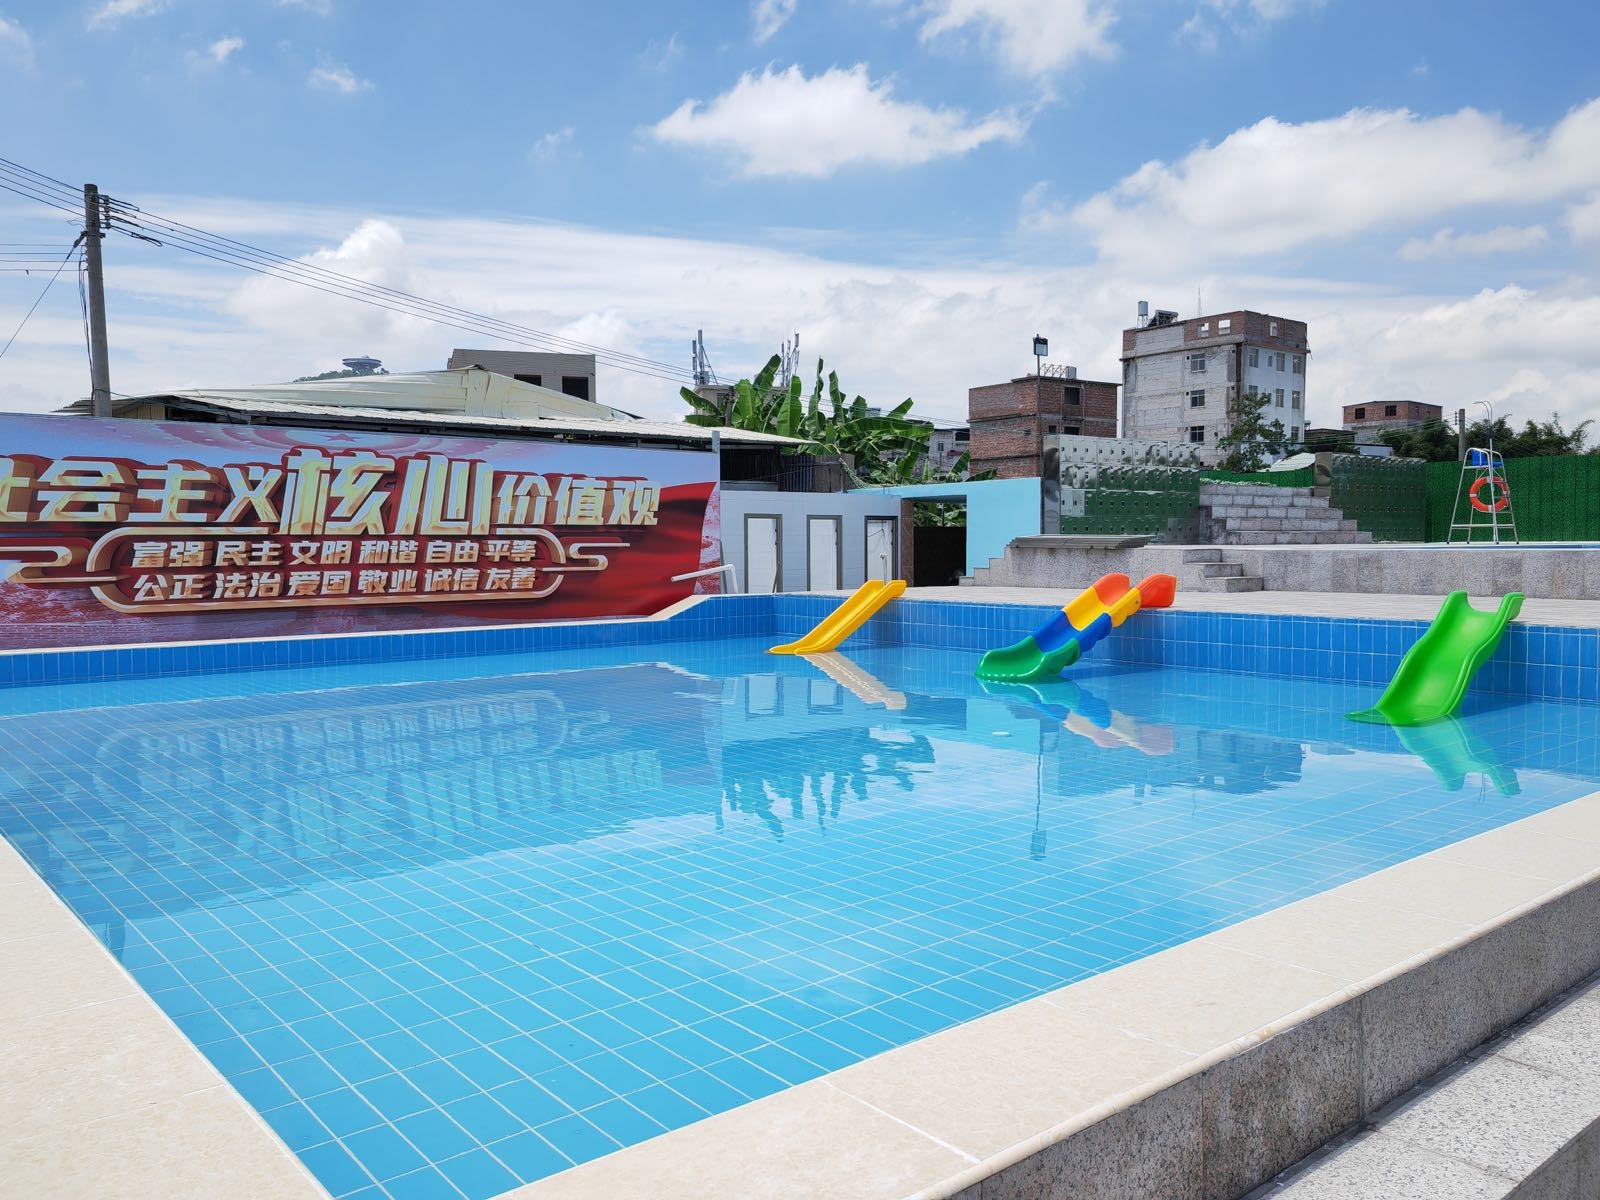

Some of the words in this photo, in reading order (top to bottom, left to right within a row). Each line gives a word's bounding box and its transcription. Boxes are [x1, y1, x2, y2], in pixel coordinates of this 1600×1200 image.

[132, 541, 205, 568] 富强
[215, 541, 282, 566] 民主
[289, 540, 352, 565] 文明
[358, 540, 418, 564] 和谐
[425, 540, 480, 563] 自由
[486, 540, 537, 562] 平等
[133, 574, 204, 601] 公正
[213, 571, 282, 598] 法治
[288, 570, 352, 596] 爱国
[358, 569, 418, 593] 敬业
[425, 568, 480, 591] 诚信
[486, 567, 536, 590] 友善
